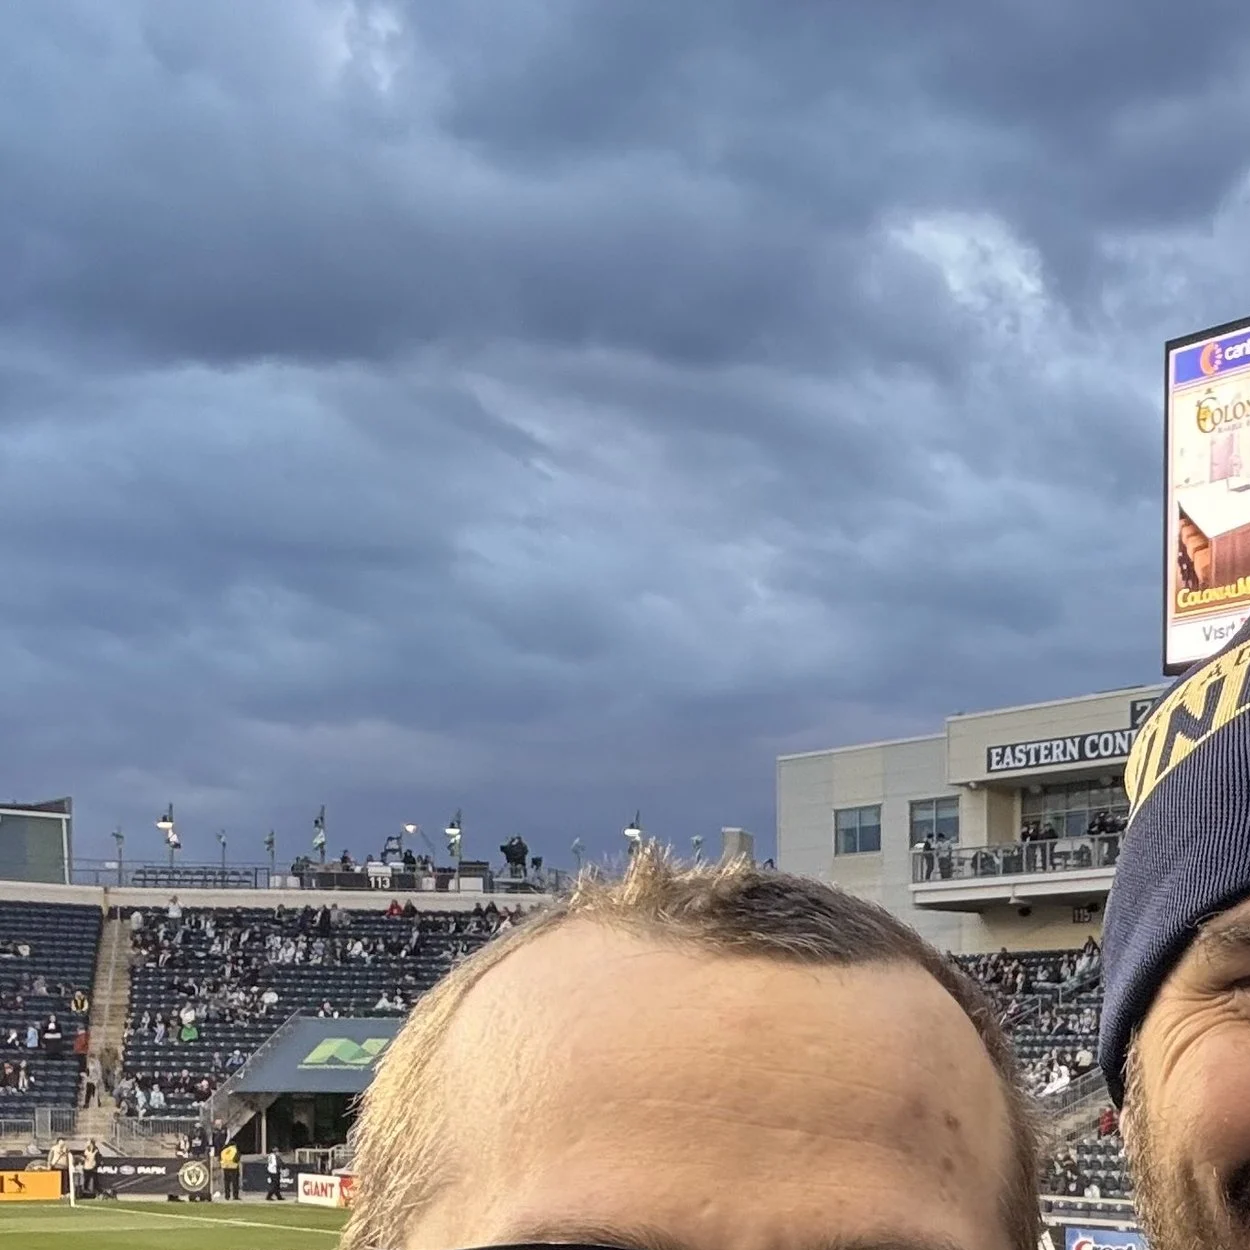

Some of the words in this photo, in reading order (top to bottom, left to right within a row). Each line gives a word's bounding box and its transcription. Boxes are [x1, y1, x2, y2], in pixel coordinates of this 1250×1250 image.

[989, 737, 1082, 770] EASTERN
[369, 876, 391, 889] 113
[303, 1179, 335, 1199] GIANT
